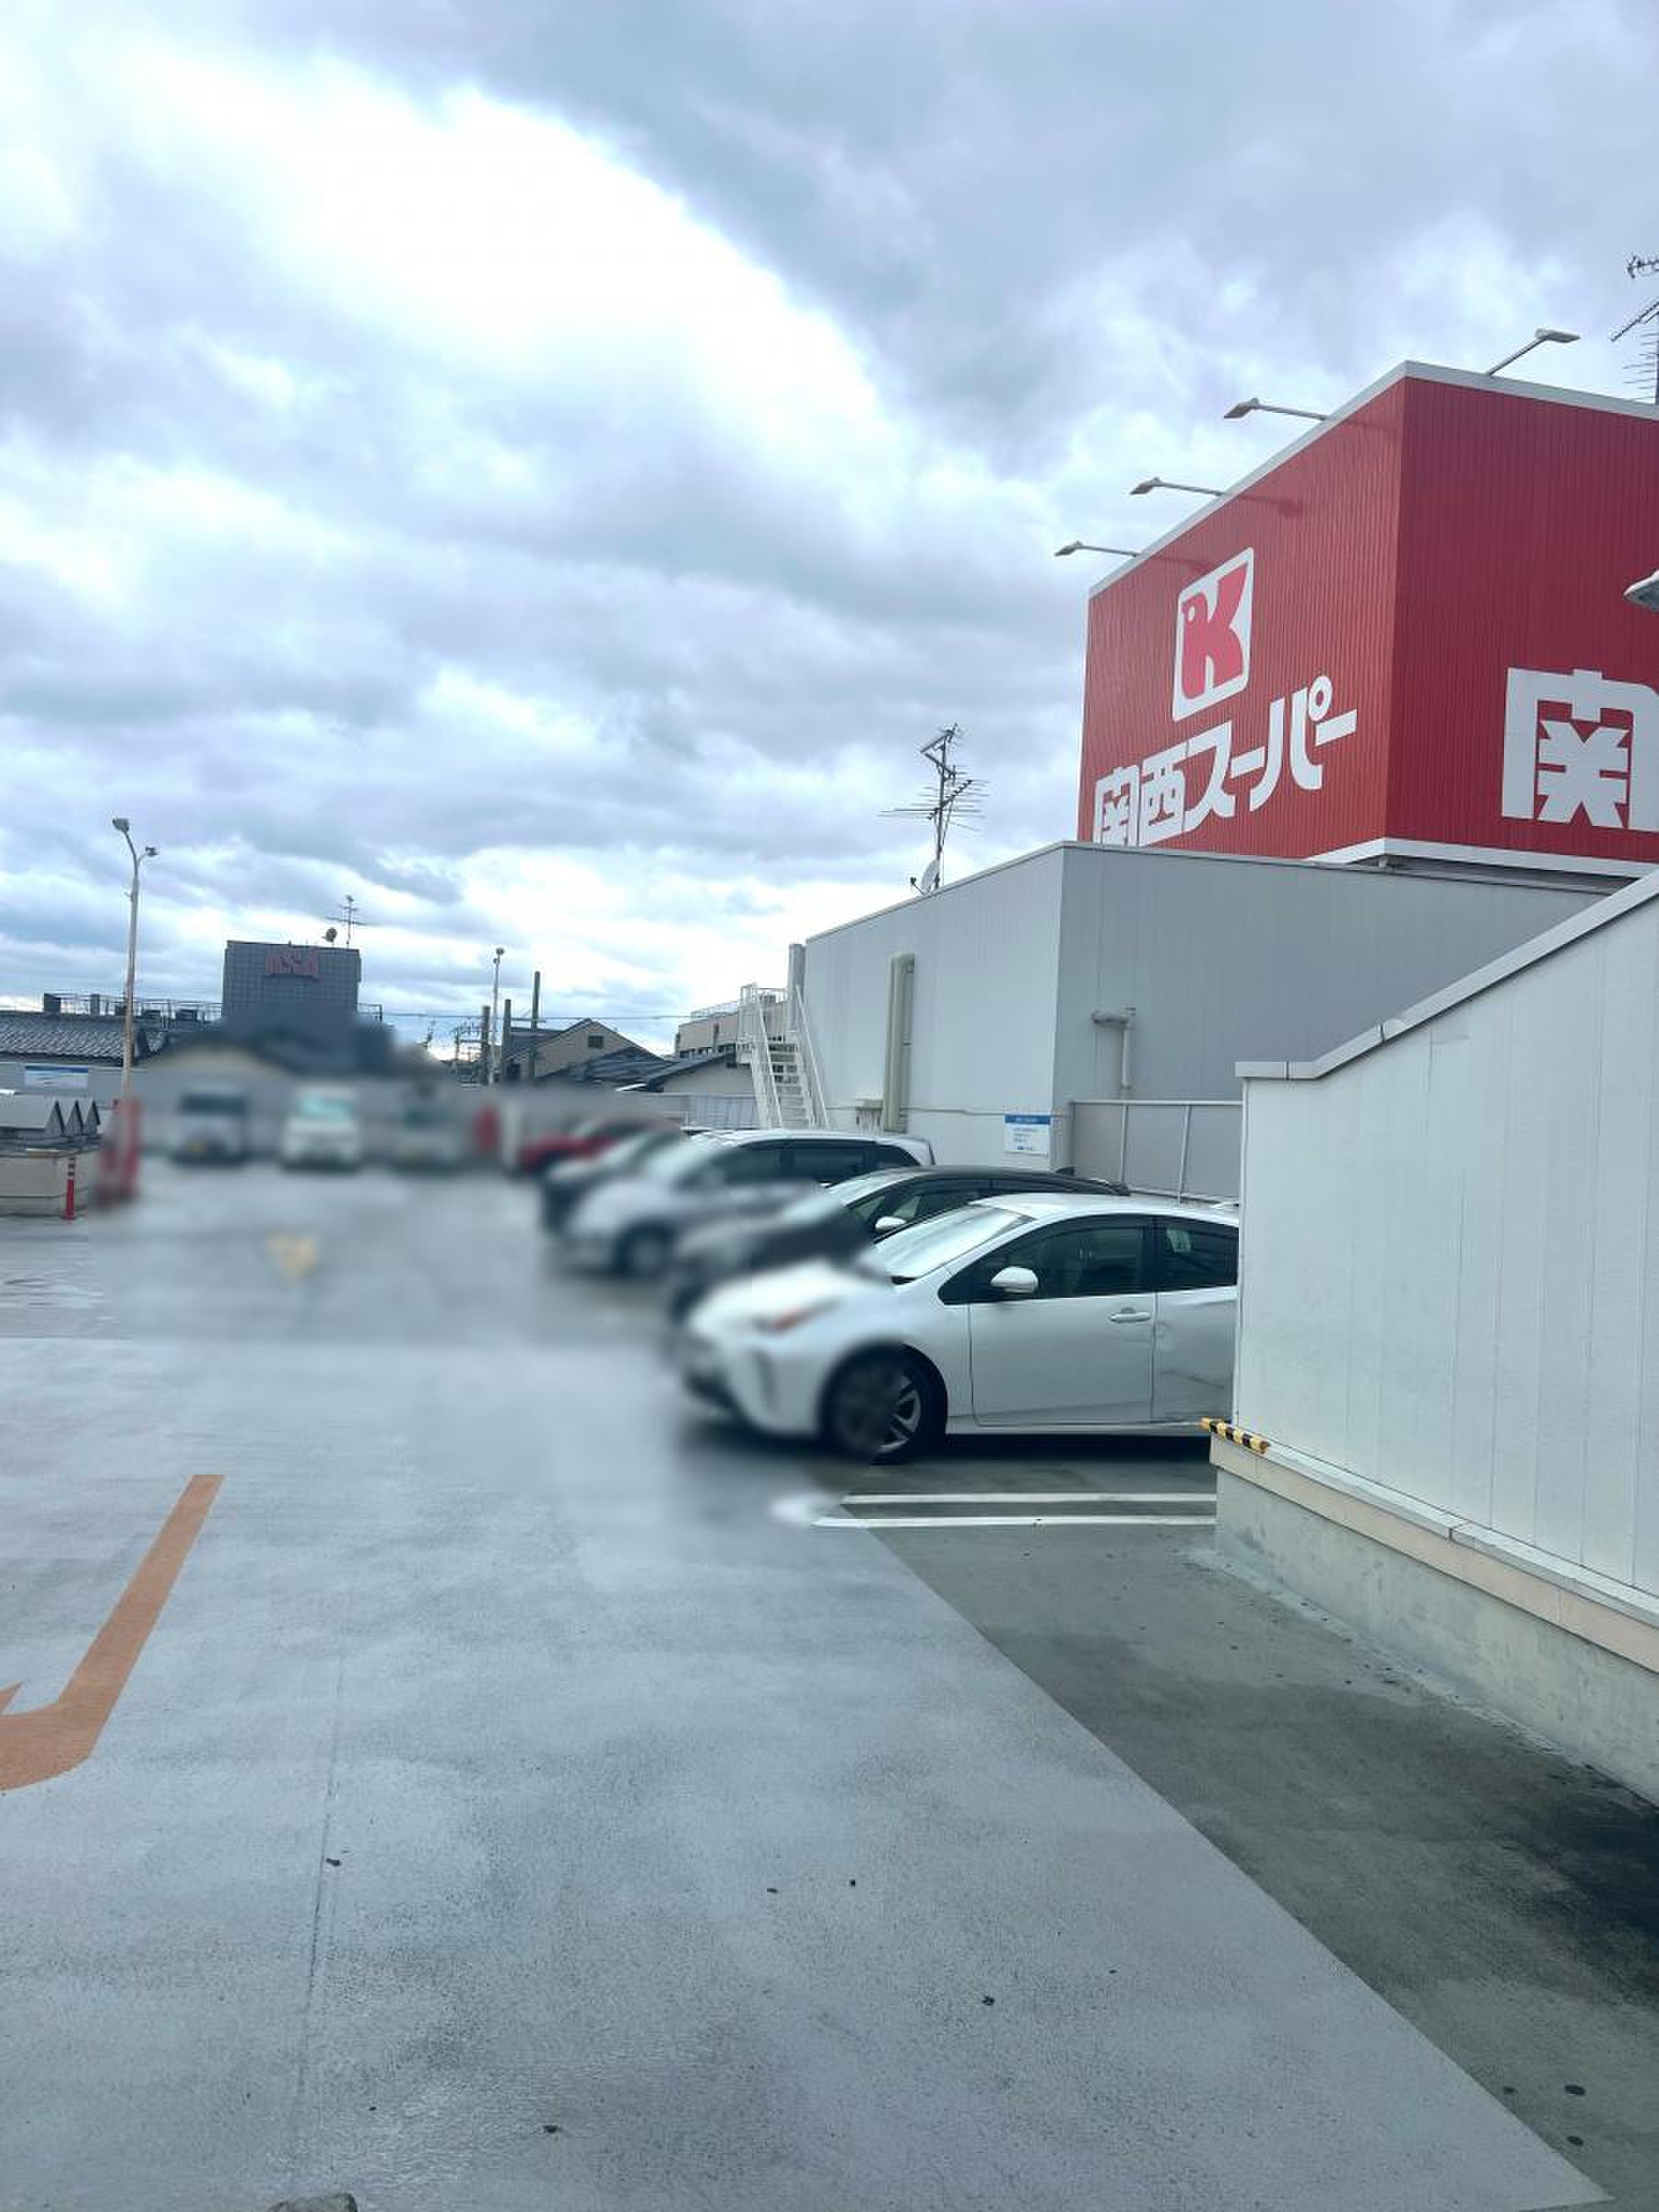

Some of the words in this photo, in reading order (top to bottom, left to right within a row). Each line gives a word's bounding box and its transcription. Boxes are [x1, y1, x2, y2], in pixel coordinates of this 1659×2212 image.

[1179, 559, 1250, 702] K
[1092, 676, 1357, 847] 関西スーパー
[1502, 667, 1659, 832] 関
